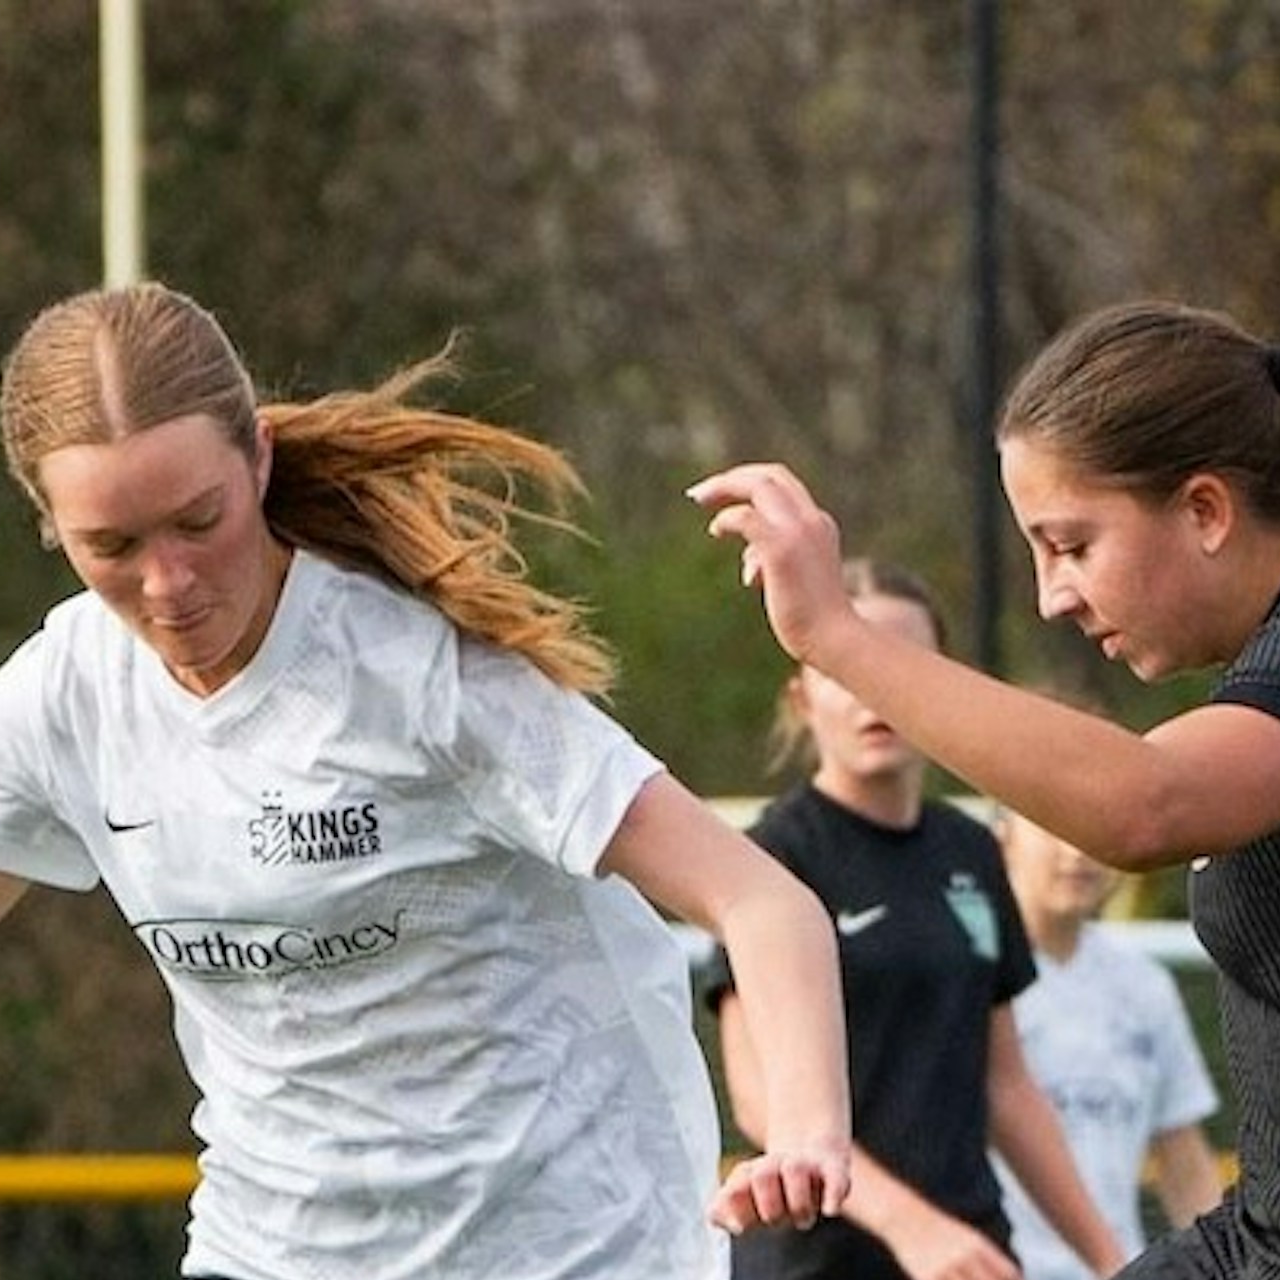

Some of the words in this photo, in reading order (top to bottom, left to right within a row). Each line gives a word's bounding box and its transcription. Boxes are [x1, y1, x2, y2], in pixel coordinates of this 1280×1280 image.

[287, 802, 379, 842] KINGS
[290, 835, 382, 864] HAMMER
[151, 908, 407, 970] OrthoCincy
